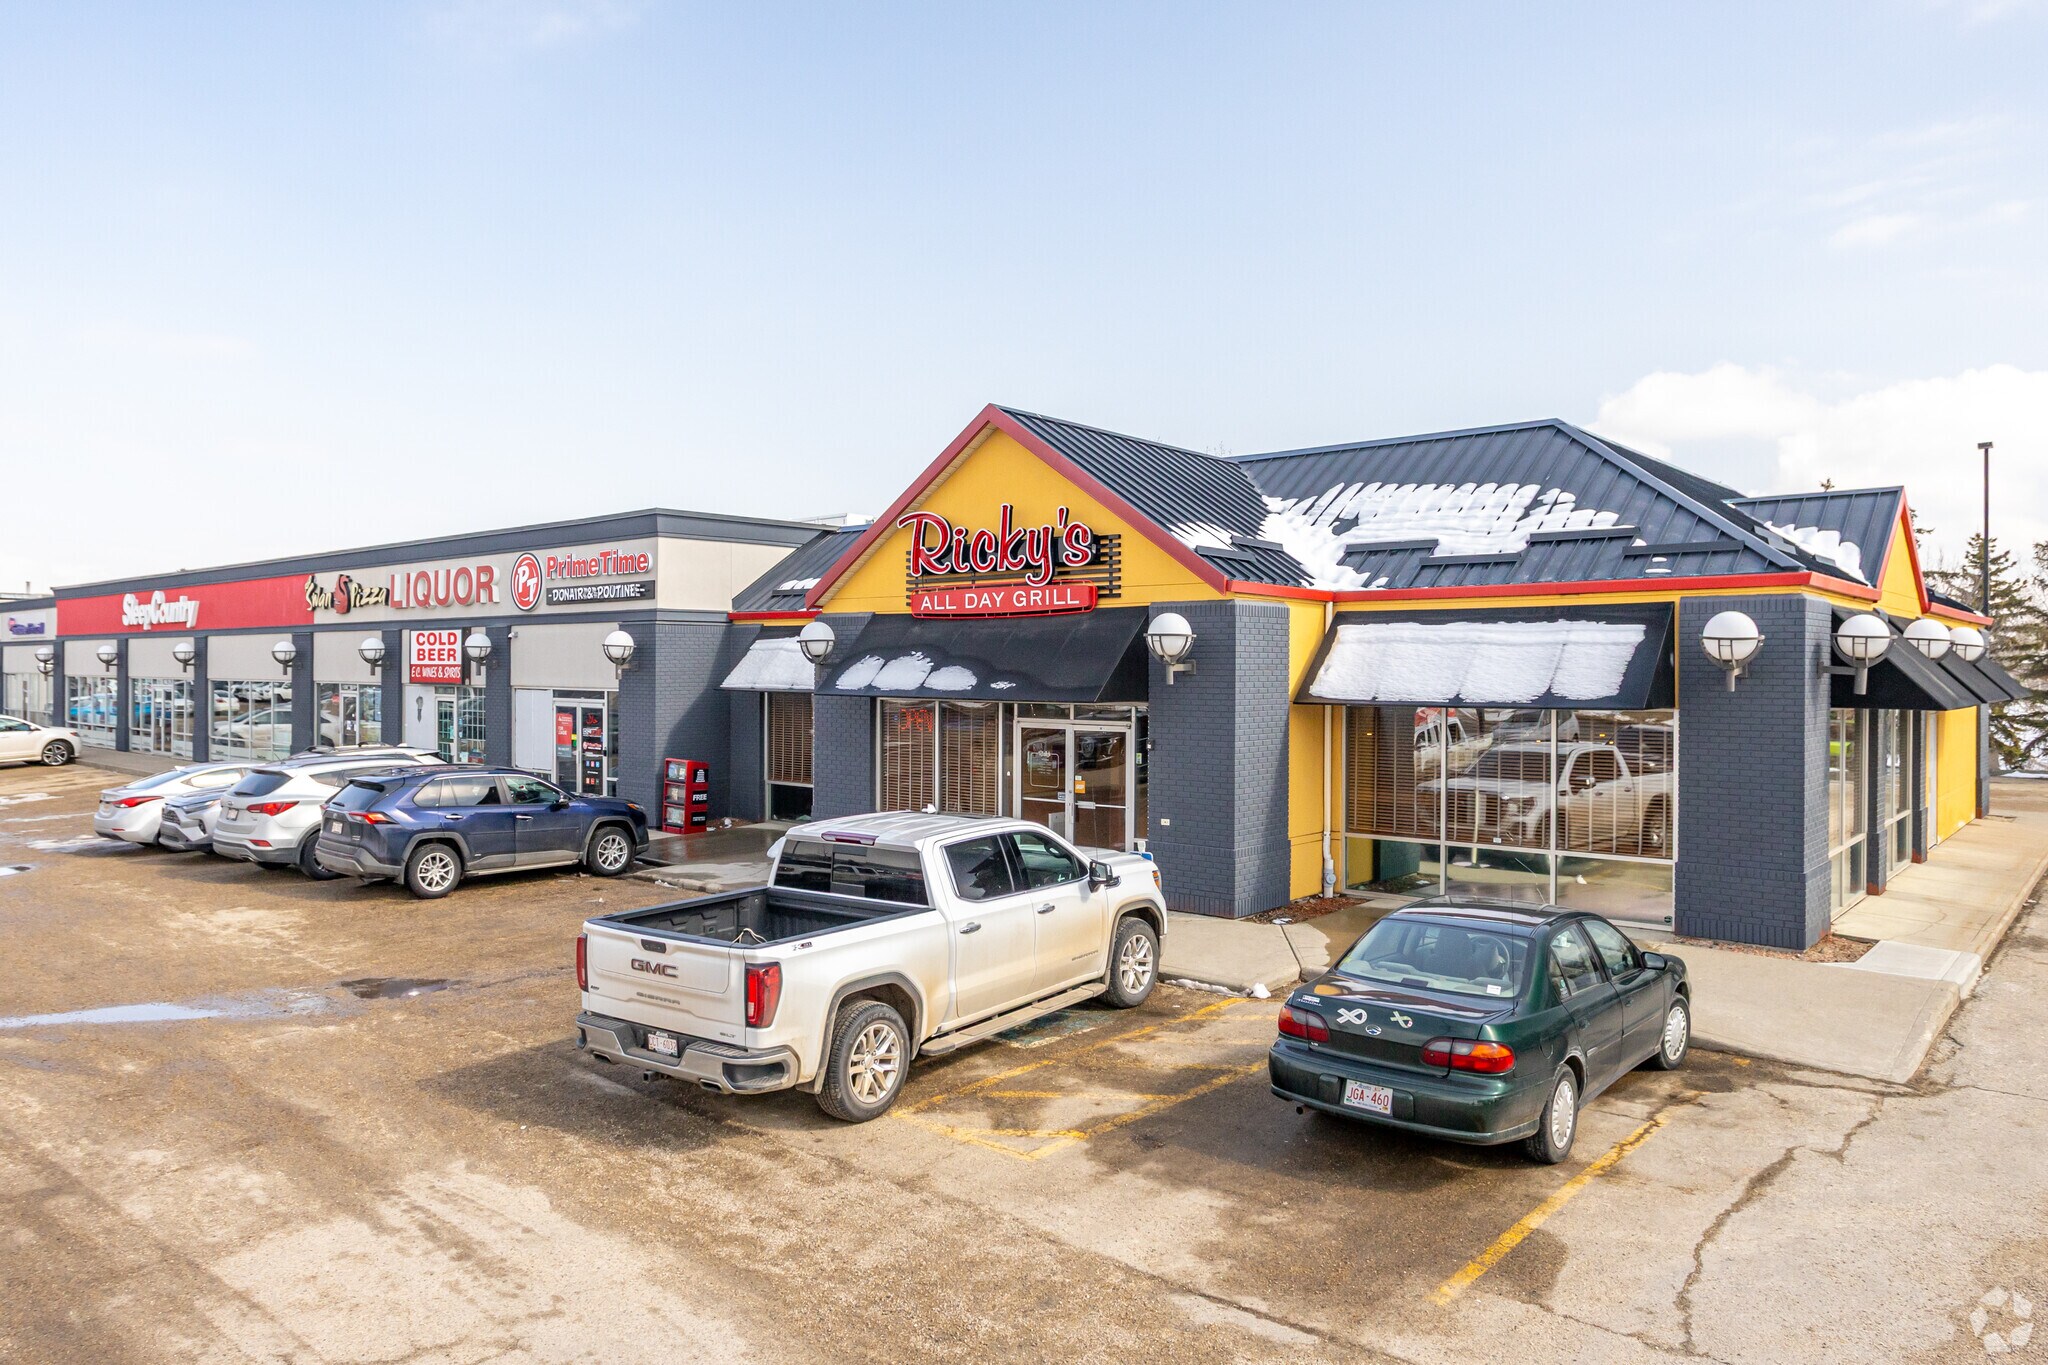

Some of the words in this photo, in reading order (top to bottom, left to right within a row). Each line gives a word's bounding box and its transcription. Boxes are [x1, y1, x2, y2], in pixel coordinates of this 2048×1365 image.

[897, 503, 1094, 587] Ricky's
[350, 582, 390, 608] Pizza
[390, 565, 499, 609] LIQUOR
[920, 595, 957, 611] ALL
[964, 592, 1005, 609] DAY
[1013, 588, 1080, 606] GRILL
[416, 632, 457, 646] COLD
[416, 648, 457, 662] BEER
[692, 793, 708, 802] FREE
[631, 958, 679, 979] GMC
